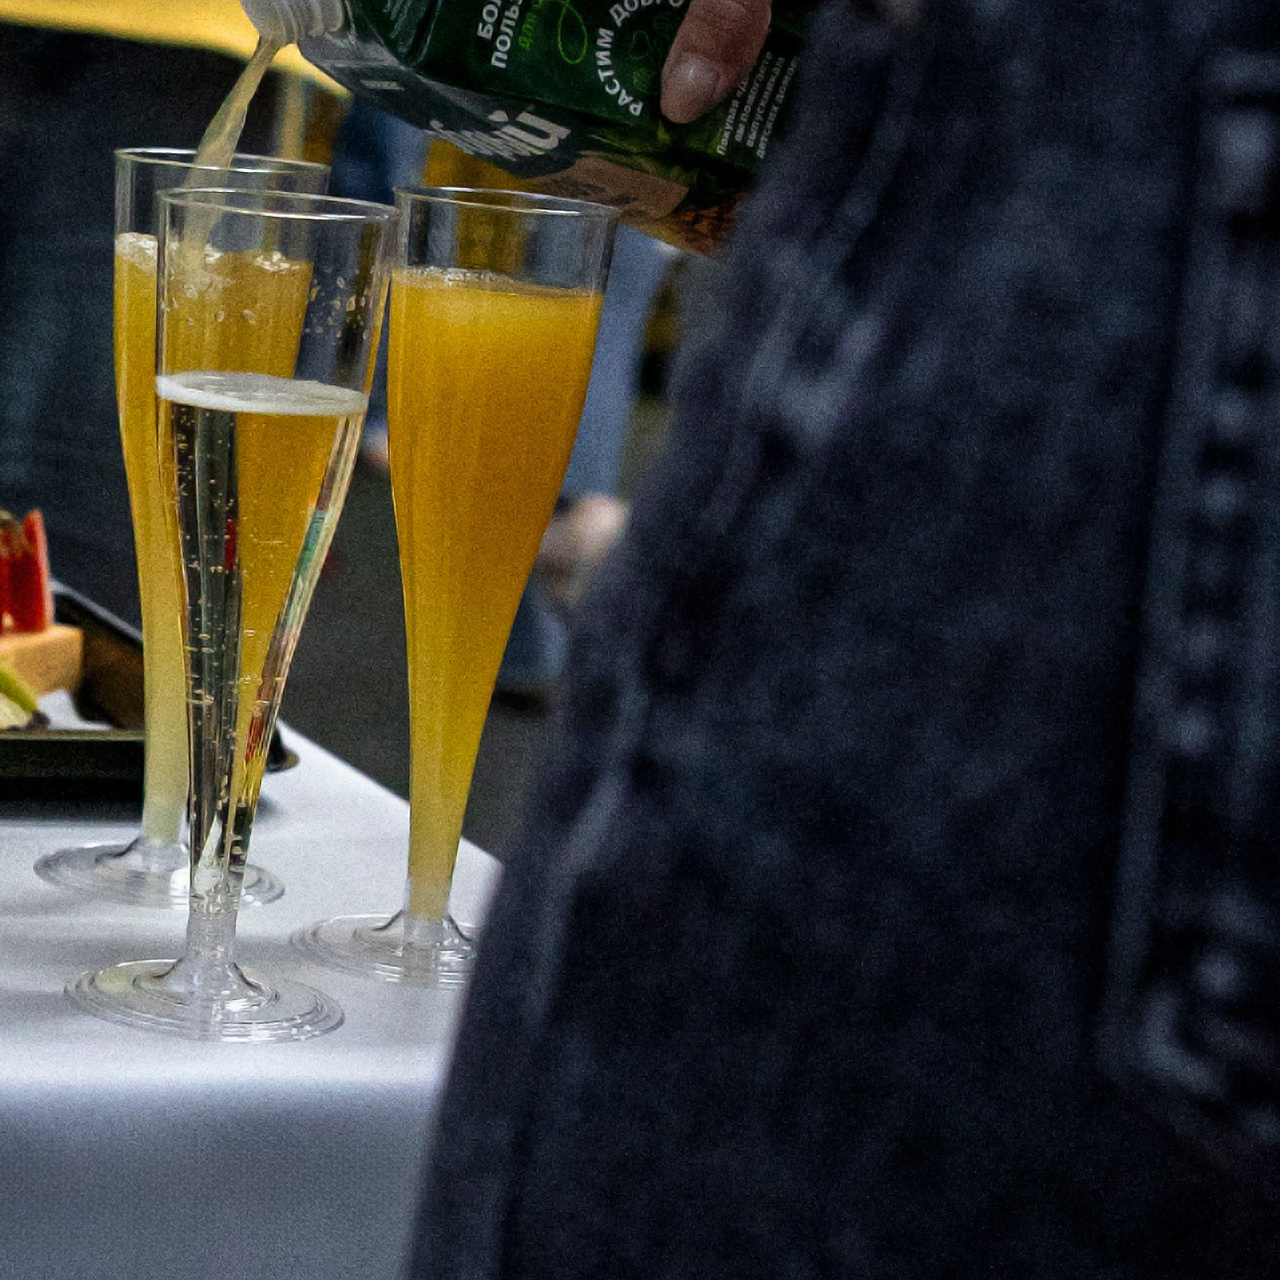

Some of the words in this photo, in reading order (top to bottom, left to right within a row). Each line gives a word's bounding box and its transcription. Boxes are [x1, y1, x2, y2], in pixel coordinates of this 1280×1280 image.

[518, 11, 538, 52] ДЛЯ
[595, 27, 644, 116] РАСТИМ
[740, 51, 773, 122] помогаете
[745, 57, 786, 148] выпускникам
[716, 100, 739, 156] Покупая
[756, 104, 780, 159] детских
